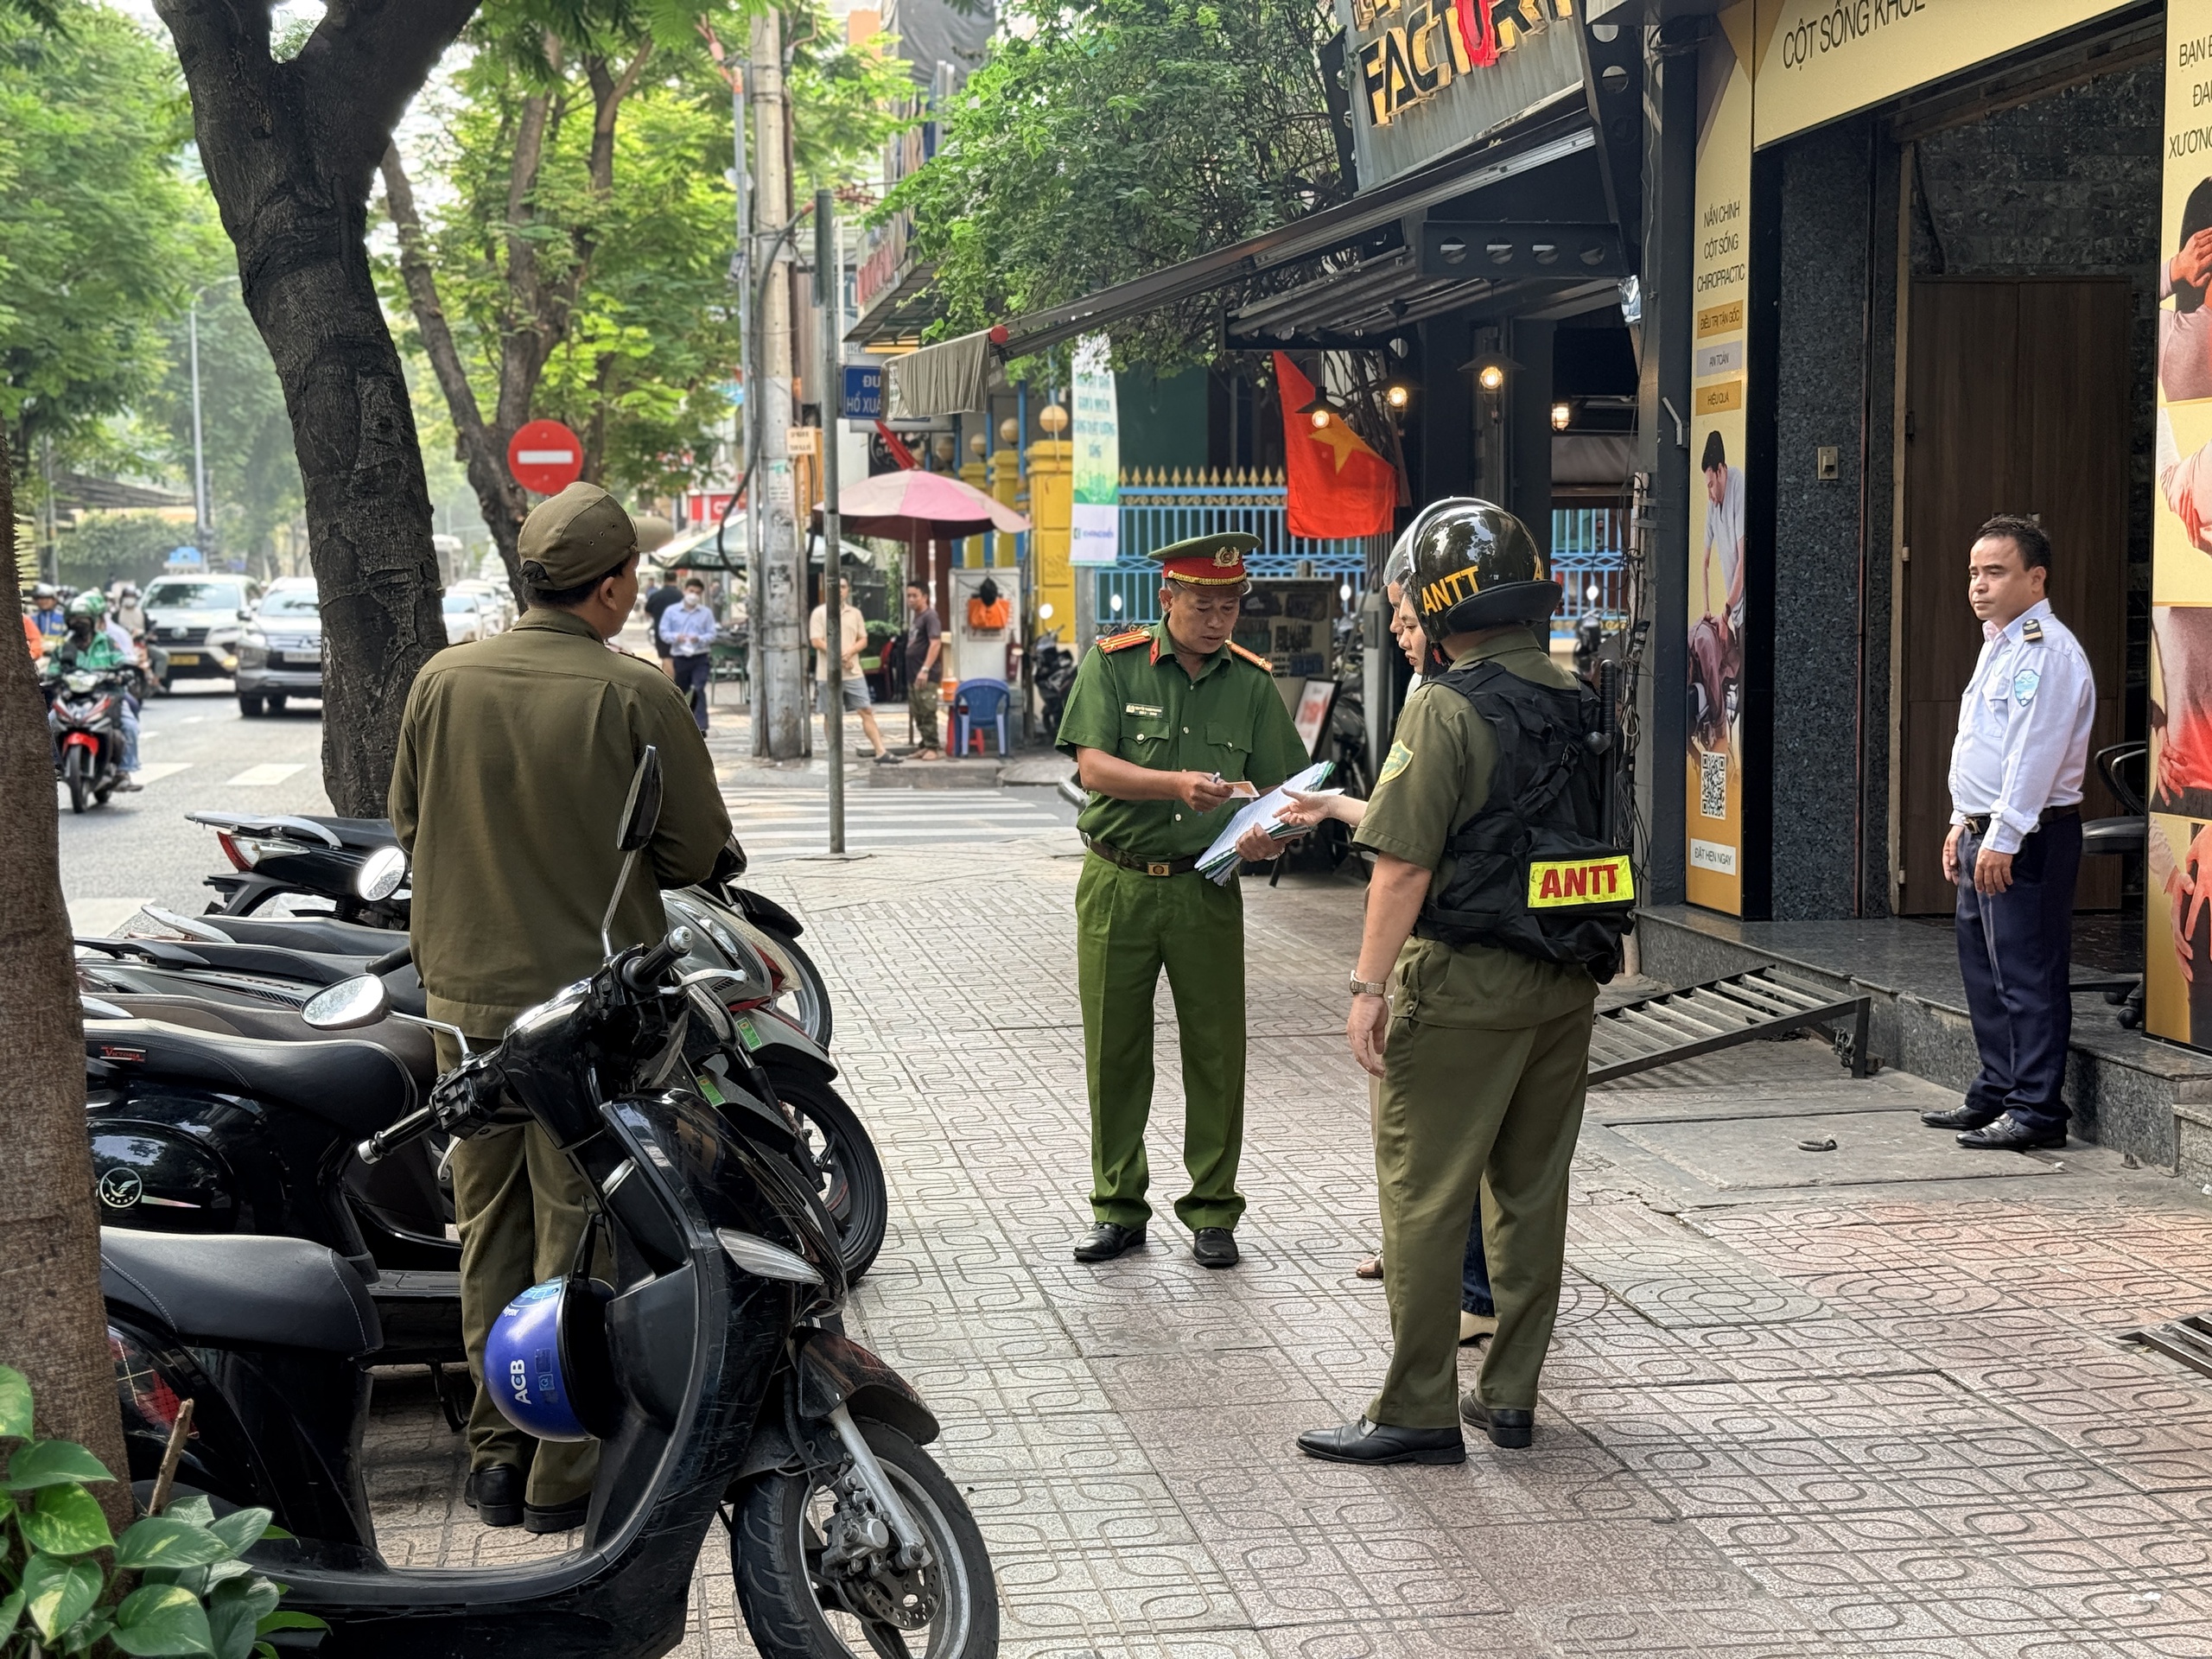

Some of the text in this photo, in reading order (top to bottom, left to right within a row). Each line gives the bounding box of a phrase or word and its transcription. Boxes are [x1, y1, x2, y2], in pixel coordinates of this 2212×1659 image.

[1783, 18, 1817, 71] CỘT
[2179, 37, 2205, 67] BẠN
[2193, 80, 2212, 107] ĐA
[1704, 230, 1738, 260] CỘT SỐNG
[1696, 264, 1745, 293] CHIROPRACTIC
[1709, 356, 1716, 367] AN
[1421, 565, 1480, 616] ANTT
[1718, 853, 1732, 866] NGAY
[1539, 864, 1619, 899] ANTT
[510, 1359, 532, 1405] ACB
